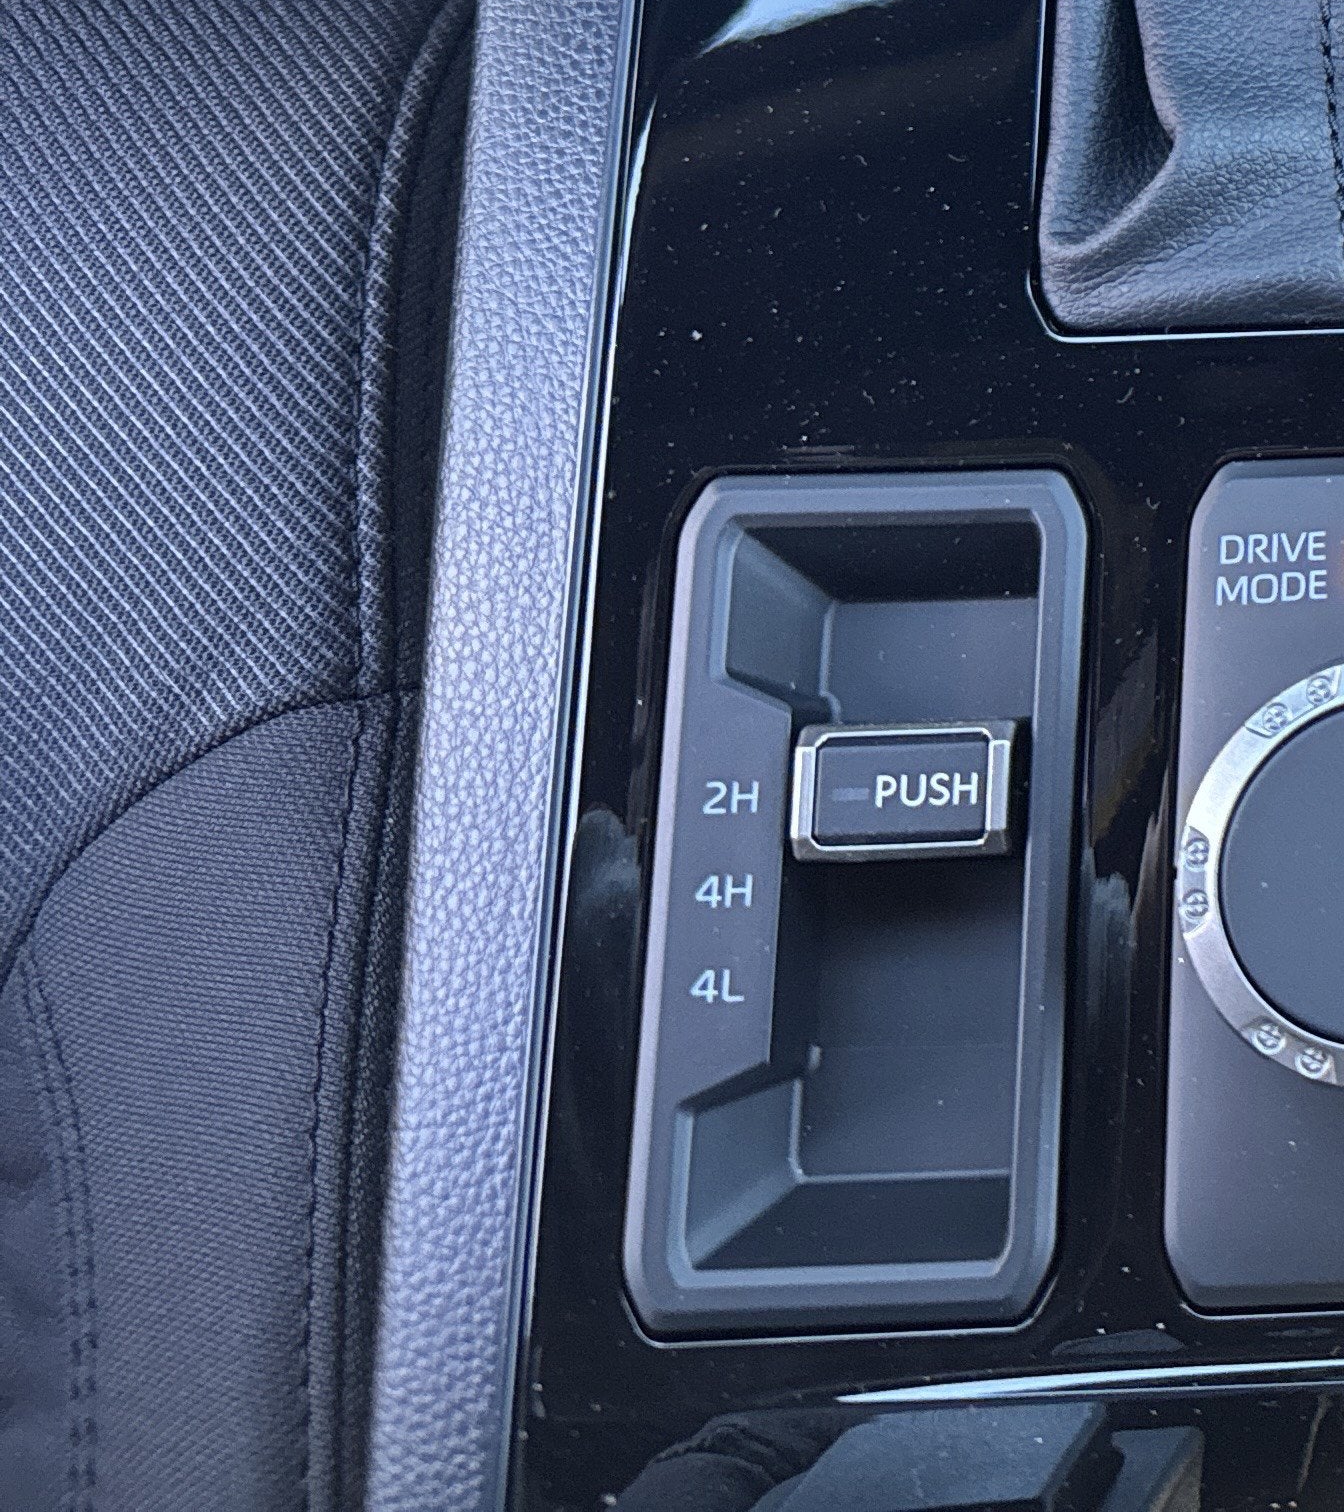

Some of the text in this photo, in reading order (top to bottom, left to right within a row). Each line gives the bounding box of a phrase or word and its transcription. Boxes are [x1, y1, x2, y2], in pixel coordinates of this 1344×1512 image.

[1218, 530, 1327, 565] DRIVE
[1215, 569, 1328, 606] MODE
[702, 781, 760, 815] 2H
[874, 772, 979, 808] PUSH
[694, 874, 754, 908] 4H
[690, 969, 745, 1003] 4L
